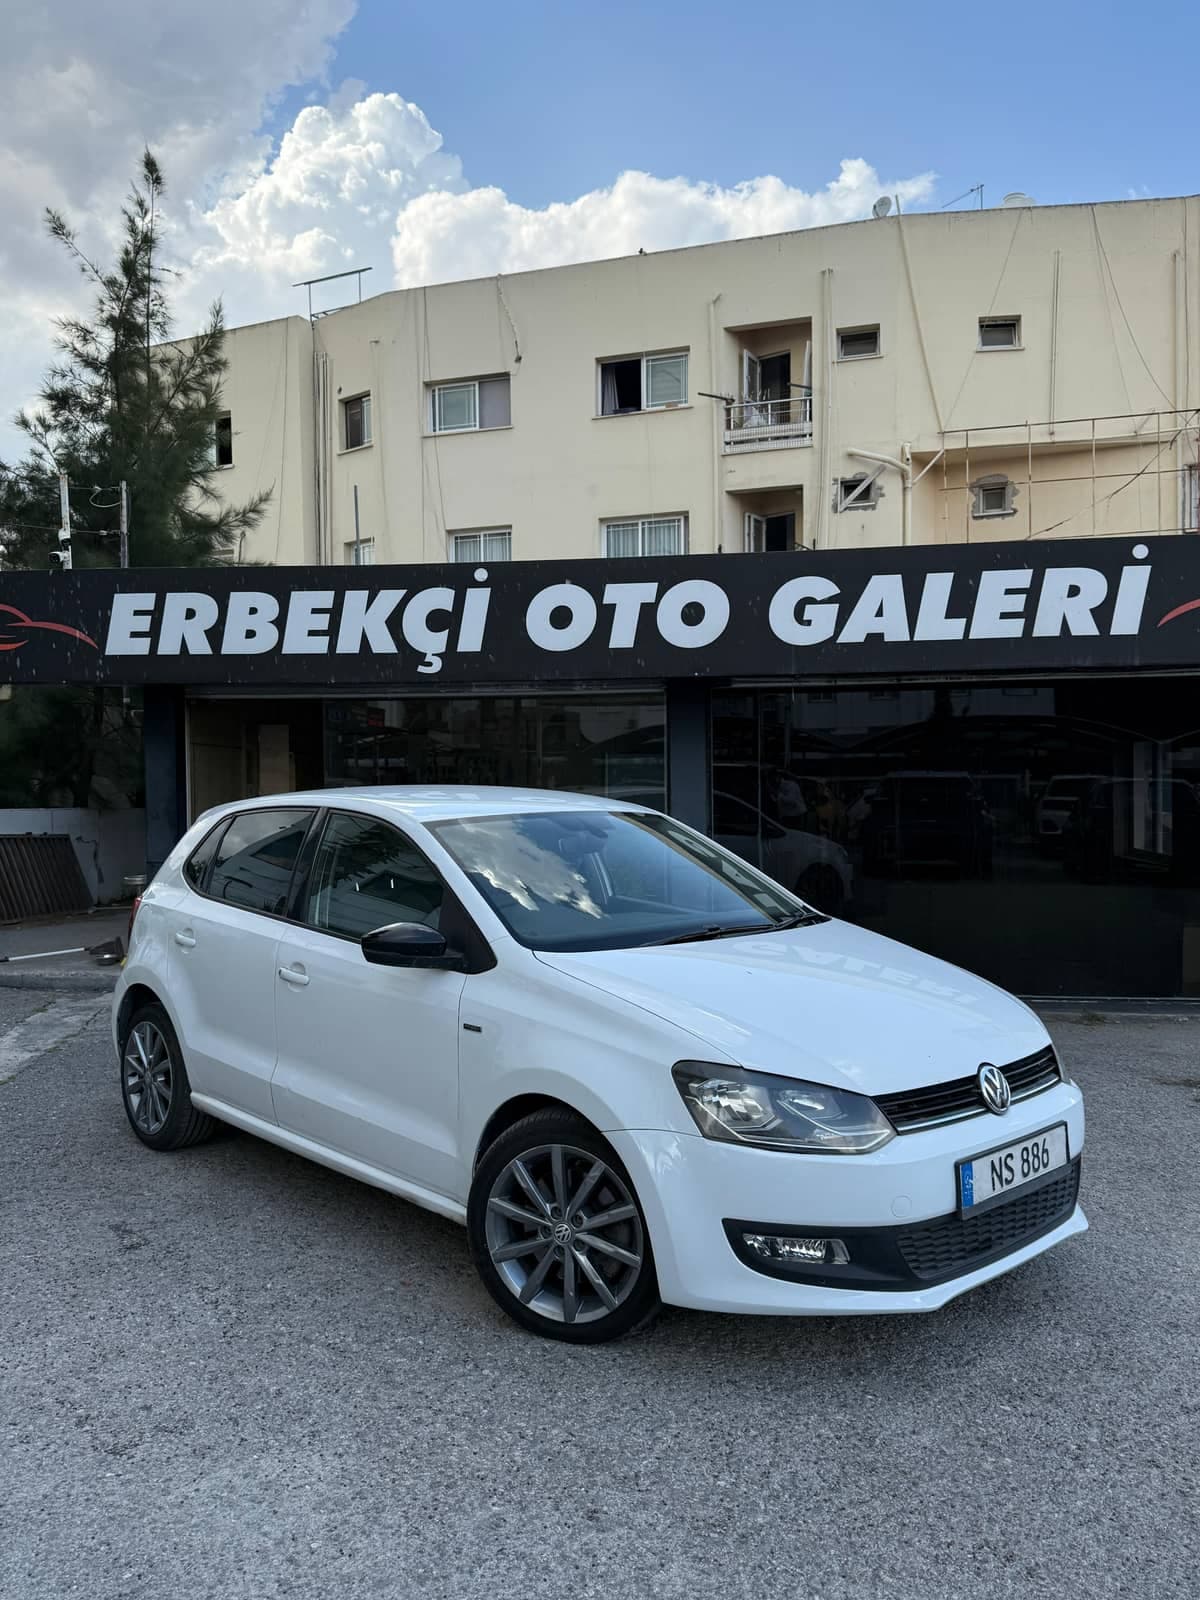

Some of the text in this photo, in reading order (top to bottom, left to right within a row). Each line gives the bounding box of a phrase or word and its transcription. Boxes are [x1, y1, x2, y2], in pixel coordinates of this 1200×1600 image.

[105, 544, 1152, 674] ERBEKÇİ OTO GALERİ
[990, 1138, 1049, 1192] NS 886
